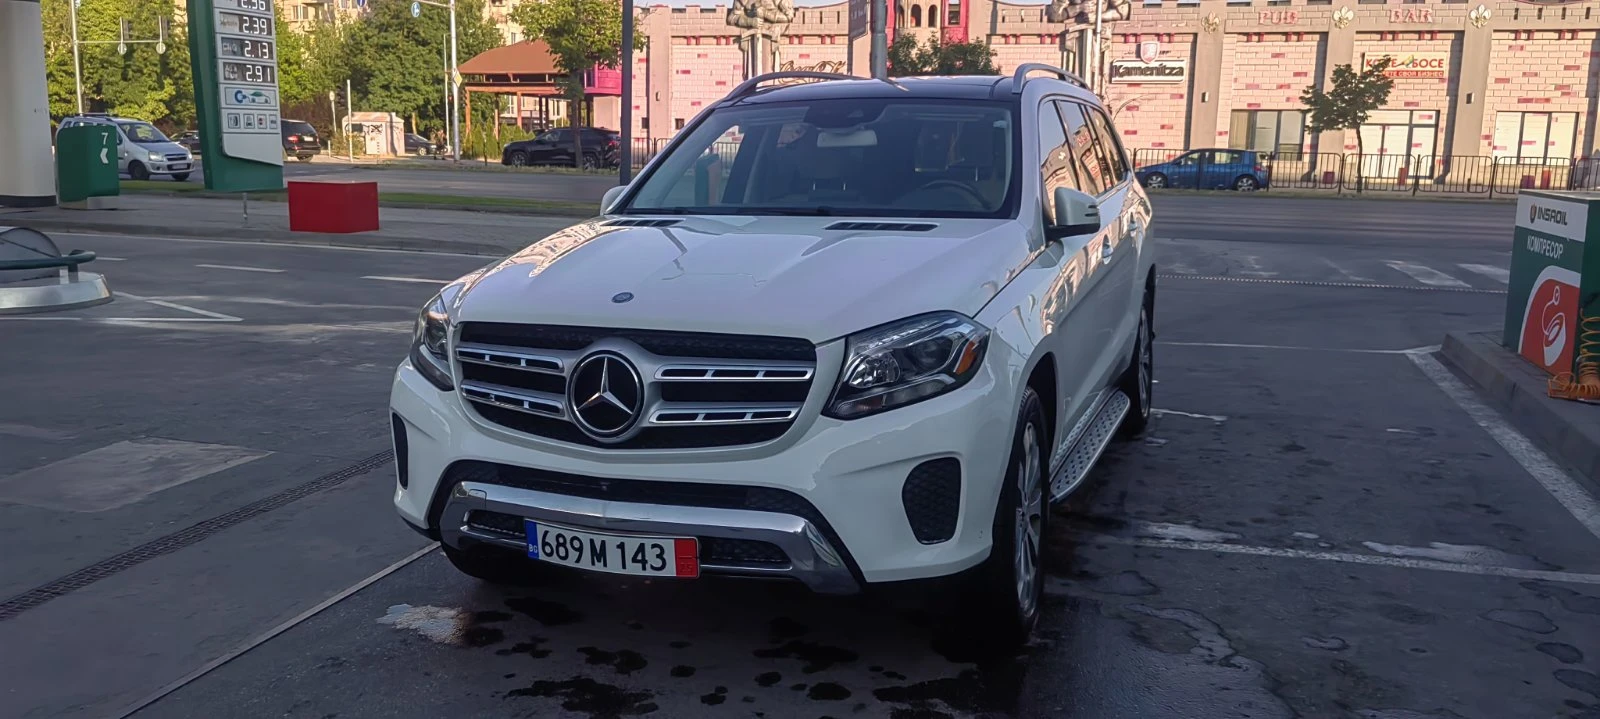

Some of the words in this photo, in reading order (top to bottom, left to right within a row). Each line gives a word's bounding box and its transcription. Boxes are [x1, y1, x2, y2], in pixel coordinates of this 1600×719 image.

[1258, 10, 1298, 25] PUB
[1389, 8, 1433, 24] BAR
[242, 16, 268, 35] 2.39
[244, 40, 269, 59] 2.13
[1113, 63, 1184, 78] Kamenitza
[1365, 58, 1397, 68] КЕ
[1412, 58, 1444, 68] БОСЕ
[246, 65, 271, 82] 2.91
[101, 132, 109, 145] 7
[1537, 206, 1568, 226] INSAOIL
[1527, 235, 1564, 260] КОМПРЕСОР
[528, 544, 538, 554] BG
[541, 530, 584, 564] 689
[589, 538, 608, 568] M
[616, 541, 667, 572] 143
